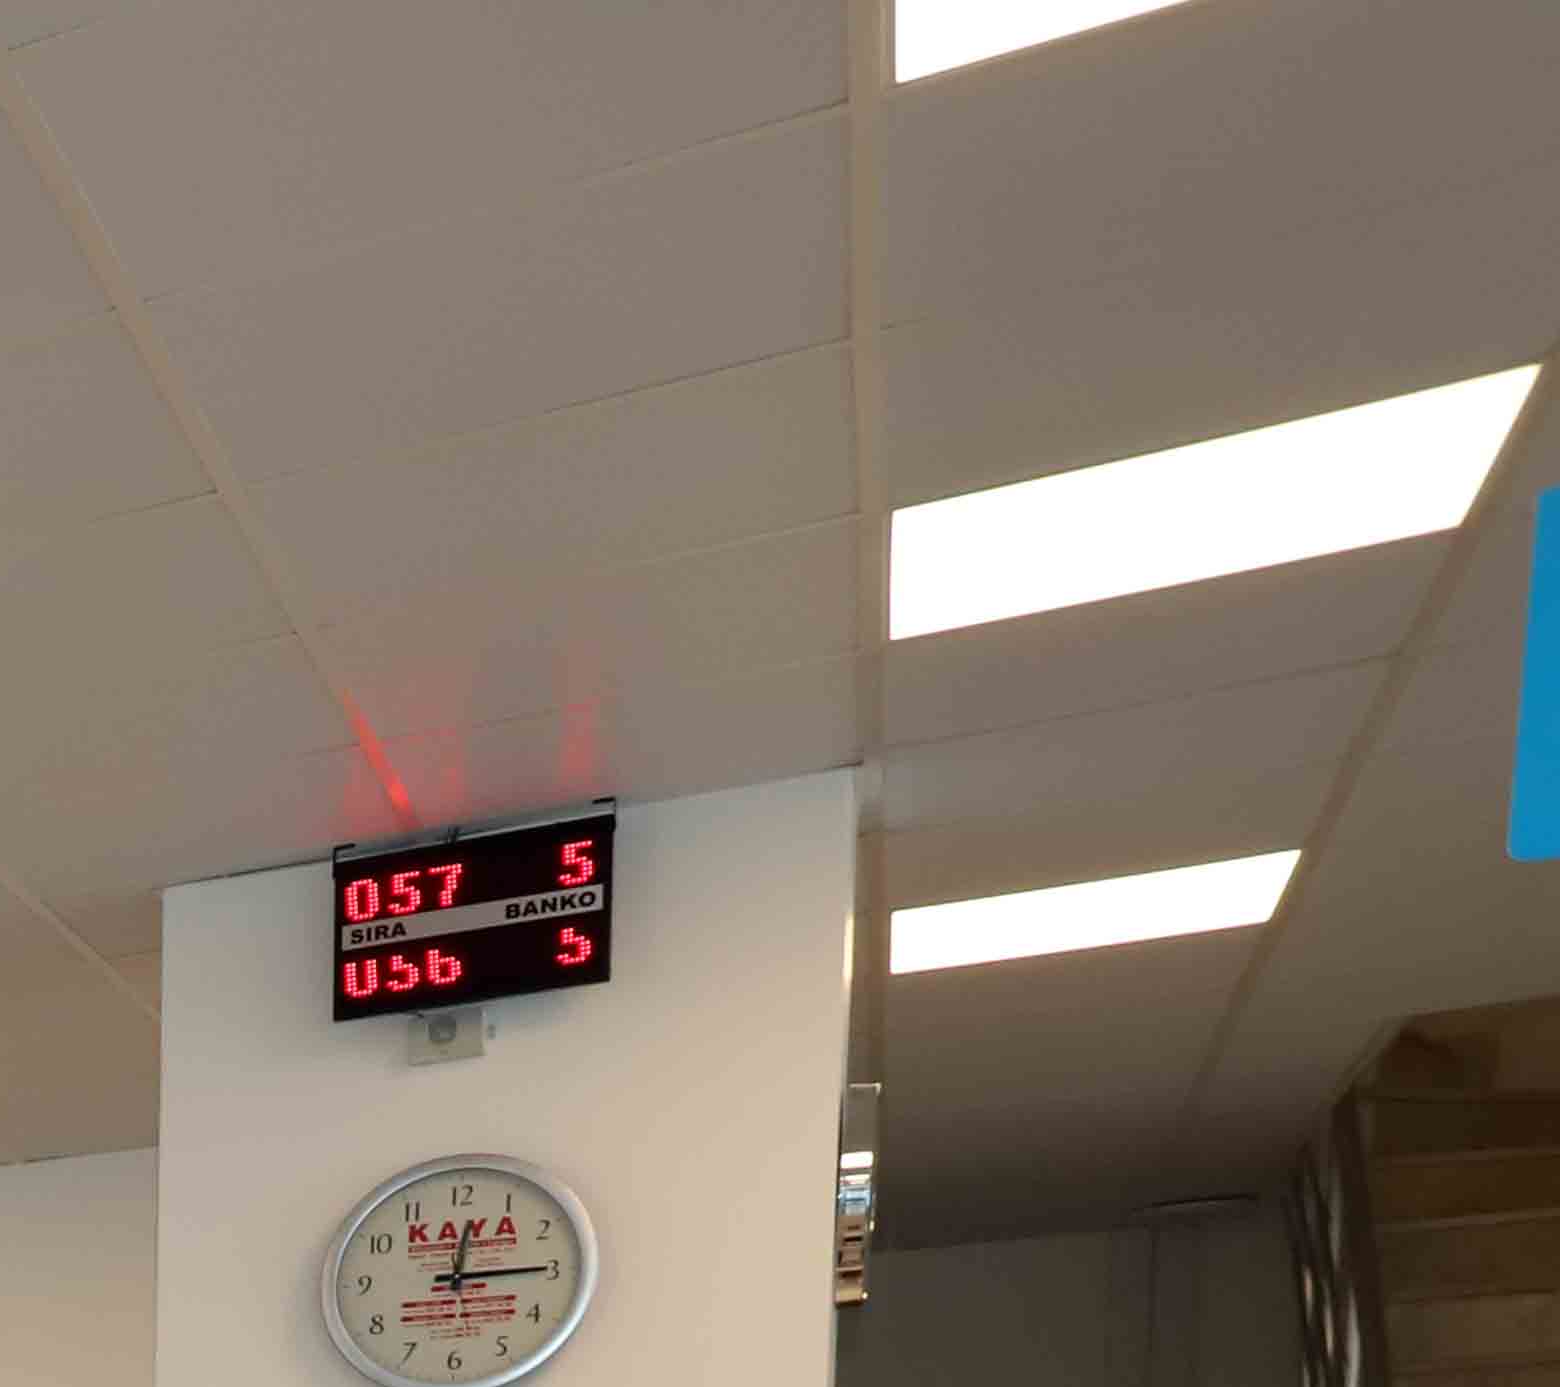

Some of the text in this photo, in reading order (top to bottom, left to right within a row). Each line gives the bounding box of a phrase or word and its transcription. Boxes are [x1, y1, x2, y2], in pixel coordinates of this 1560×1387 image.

[344, 840, 593, 920] 057 5
[350, 891, 596, 945] SIRA BANKO
[451, 1185, 474, 1207] 12
[505, 1193, 512, 1213] 1
[405, 1202, 421, 1221] 11
[408, 1216, 517, 1243] KAYA
[536, 1219, 551, 1240] 2
[369, 1233, 393, 1255] 10
[546, 1260, 560, 1280] 3
[357, 1275, 373, 1296] 9
[525, 1303, 541, 1324] 4
[369, 1314, 384, 1335] 8
[401, 1342, 417, 1364] 7
[495, 1337, 509, 1357] 5
[447, 1351, 462, 1370] 6
